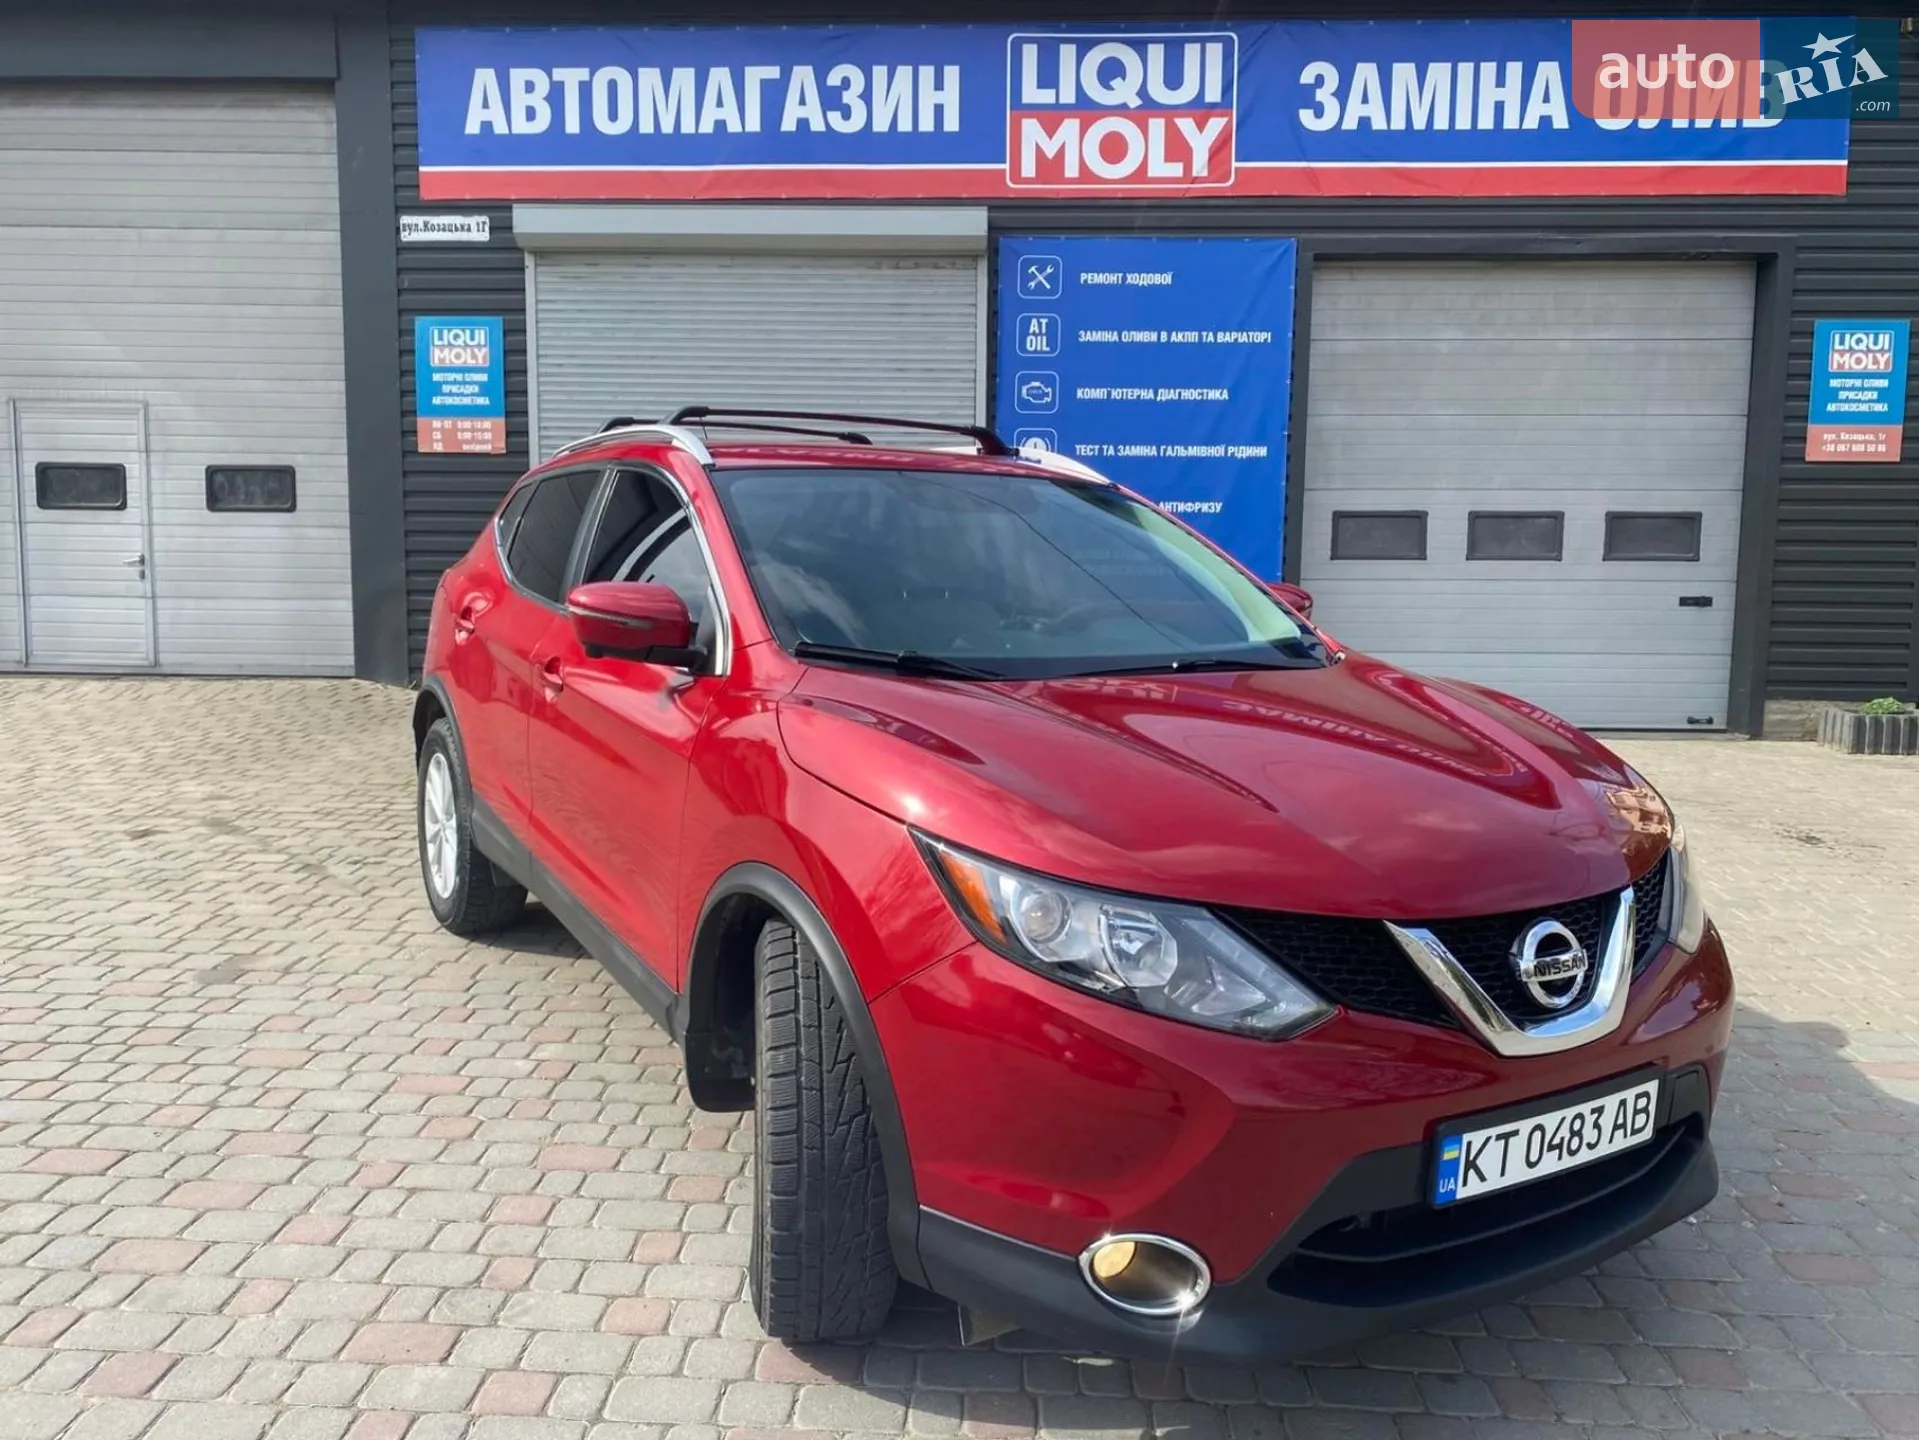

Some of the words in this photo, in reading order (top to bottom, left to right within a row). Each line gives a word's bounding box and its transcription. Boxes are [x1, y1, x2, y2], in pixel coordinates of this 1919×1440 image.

[1021, 42, 1223, 108] LIQUI
[465, 65, 961, 135] АВТОМАГАЗИН
[1299, 61, 1569, 131] ЗАМІНА
[1020, 116, 1229, 179] MOLY
[402, 220, 472, 236] вул.Козацька
[1080, 272, 1123, 285] РЕМОНТ
[1125, 271, 1173, 286] ХОДОВОЇ
[1029, 318, 1048, 333] AT
[433, 328, 486, 346] LIQUI
[1026, 336, 1050, 351] OIL
[1078, 330, 1119, 343] ЗАМІНА
[1121, 330, 1158, 343] ОЛИВИ
[1160, 331, 1168, 343] В
[1170, 331, 1199, 343] АКПП
[1201, 331, 1215, 343] ТА
[1217, 331, 1271, 344] ВАРІАТОРІ
[1833, 333, 1890, 351] LIQUI
[433, 347, 488, 364] MOLY
[1832, 352, 1890, 370] MOLY
[1156, 387, 1229, 402] ДІАГНОСТИКА
[1075, 444, 1100, 457] ТЕСТ
[1102, 444, 1115, 457] ТА
[1117, 444, 1158, 457] ЗАМІНА
[1160, 444, 1225, 458] ГАЛЬМІВНОЇ
[1227, 446, 1267, 459] РІДИНИ
[1158, 501, 1223, 514] АНТИФРИЗУ
[1533, 953, 1586, 977] NISSAN
[1462, 1129, 1520, 1187] KT
[1525, 1104, 1605, 1169] 0483
[1608, 1090, 1651, 1144] AB
[1439, 1178, 1456, 1193] UA
